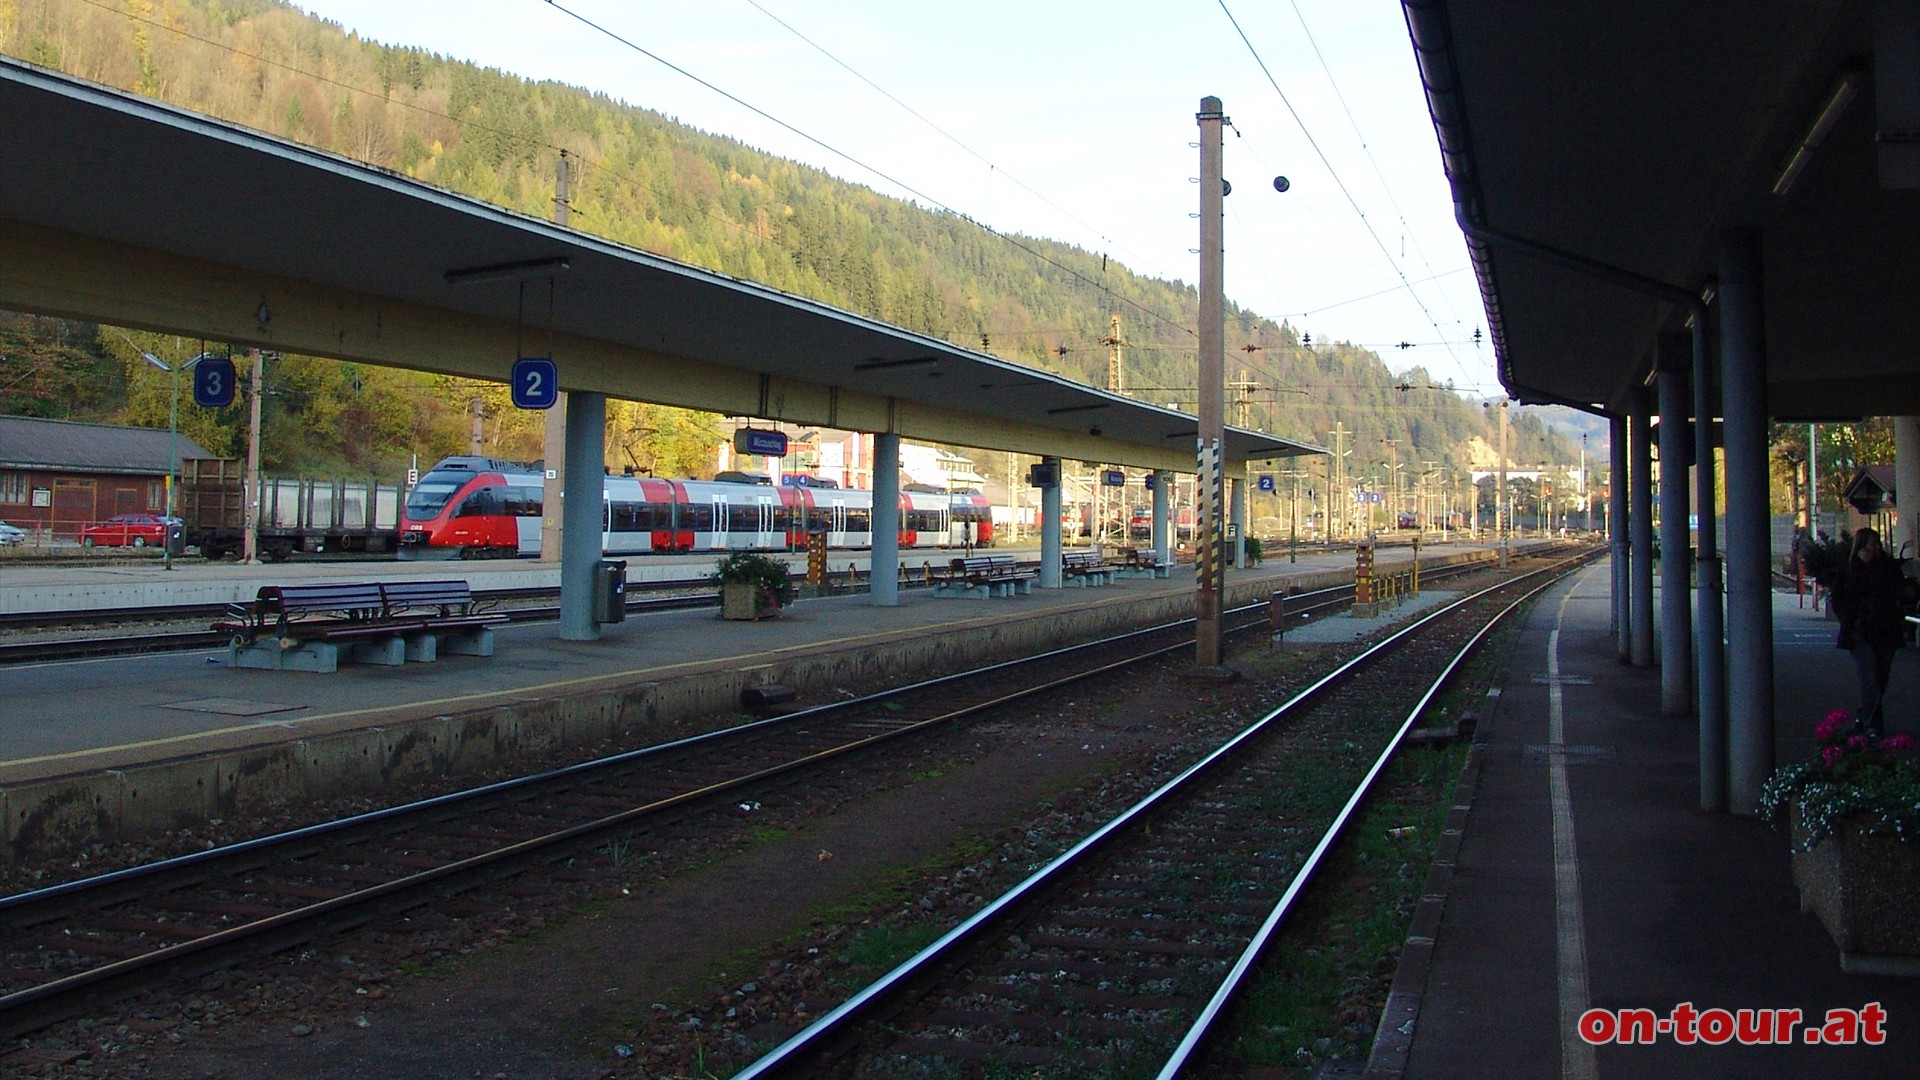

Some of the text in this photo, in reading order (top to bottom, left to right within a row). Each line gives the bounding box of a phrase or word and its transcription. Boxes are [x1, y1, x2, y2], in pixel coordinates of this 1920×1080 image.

[206, 371, 222, 396] 3
[526, 371, 542, 397] 2
[410, 471, 417, 482] E
[1263, 479, 1271, 488] 2
